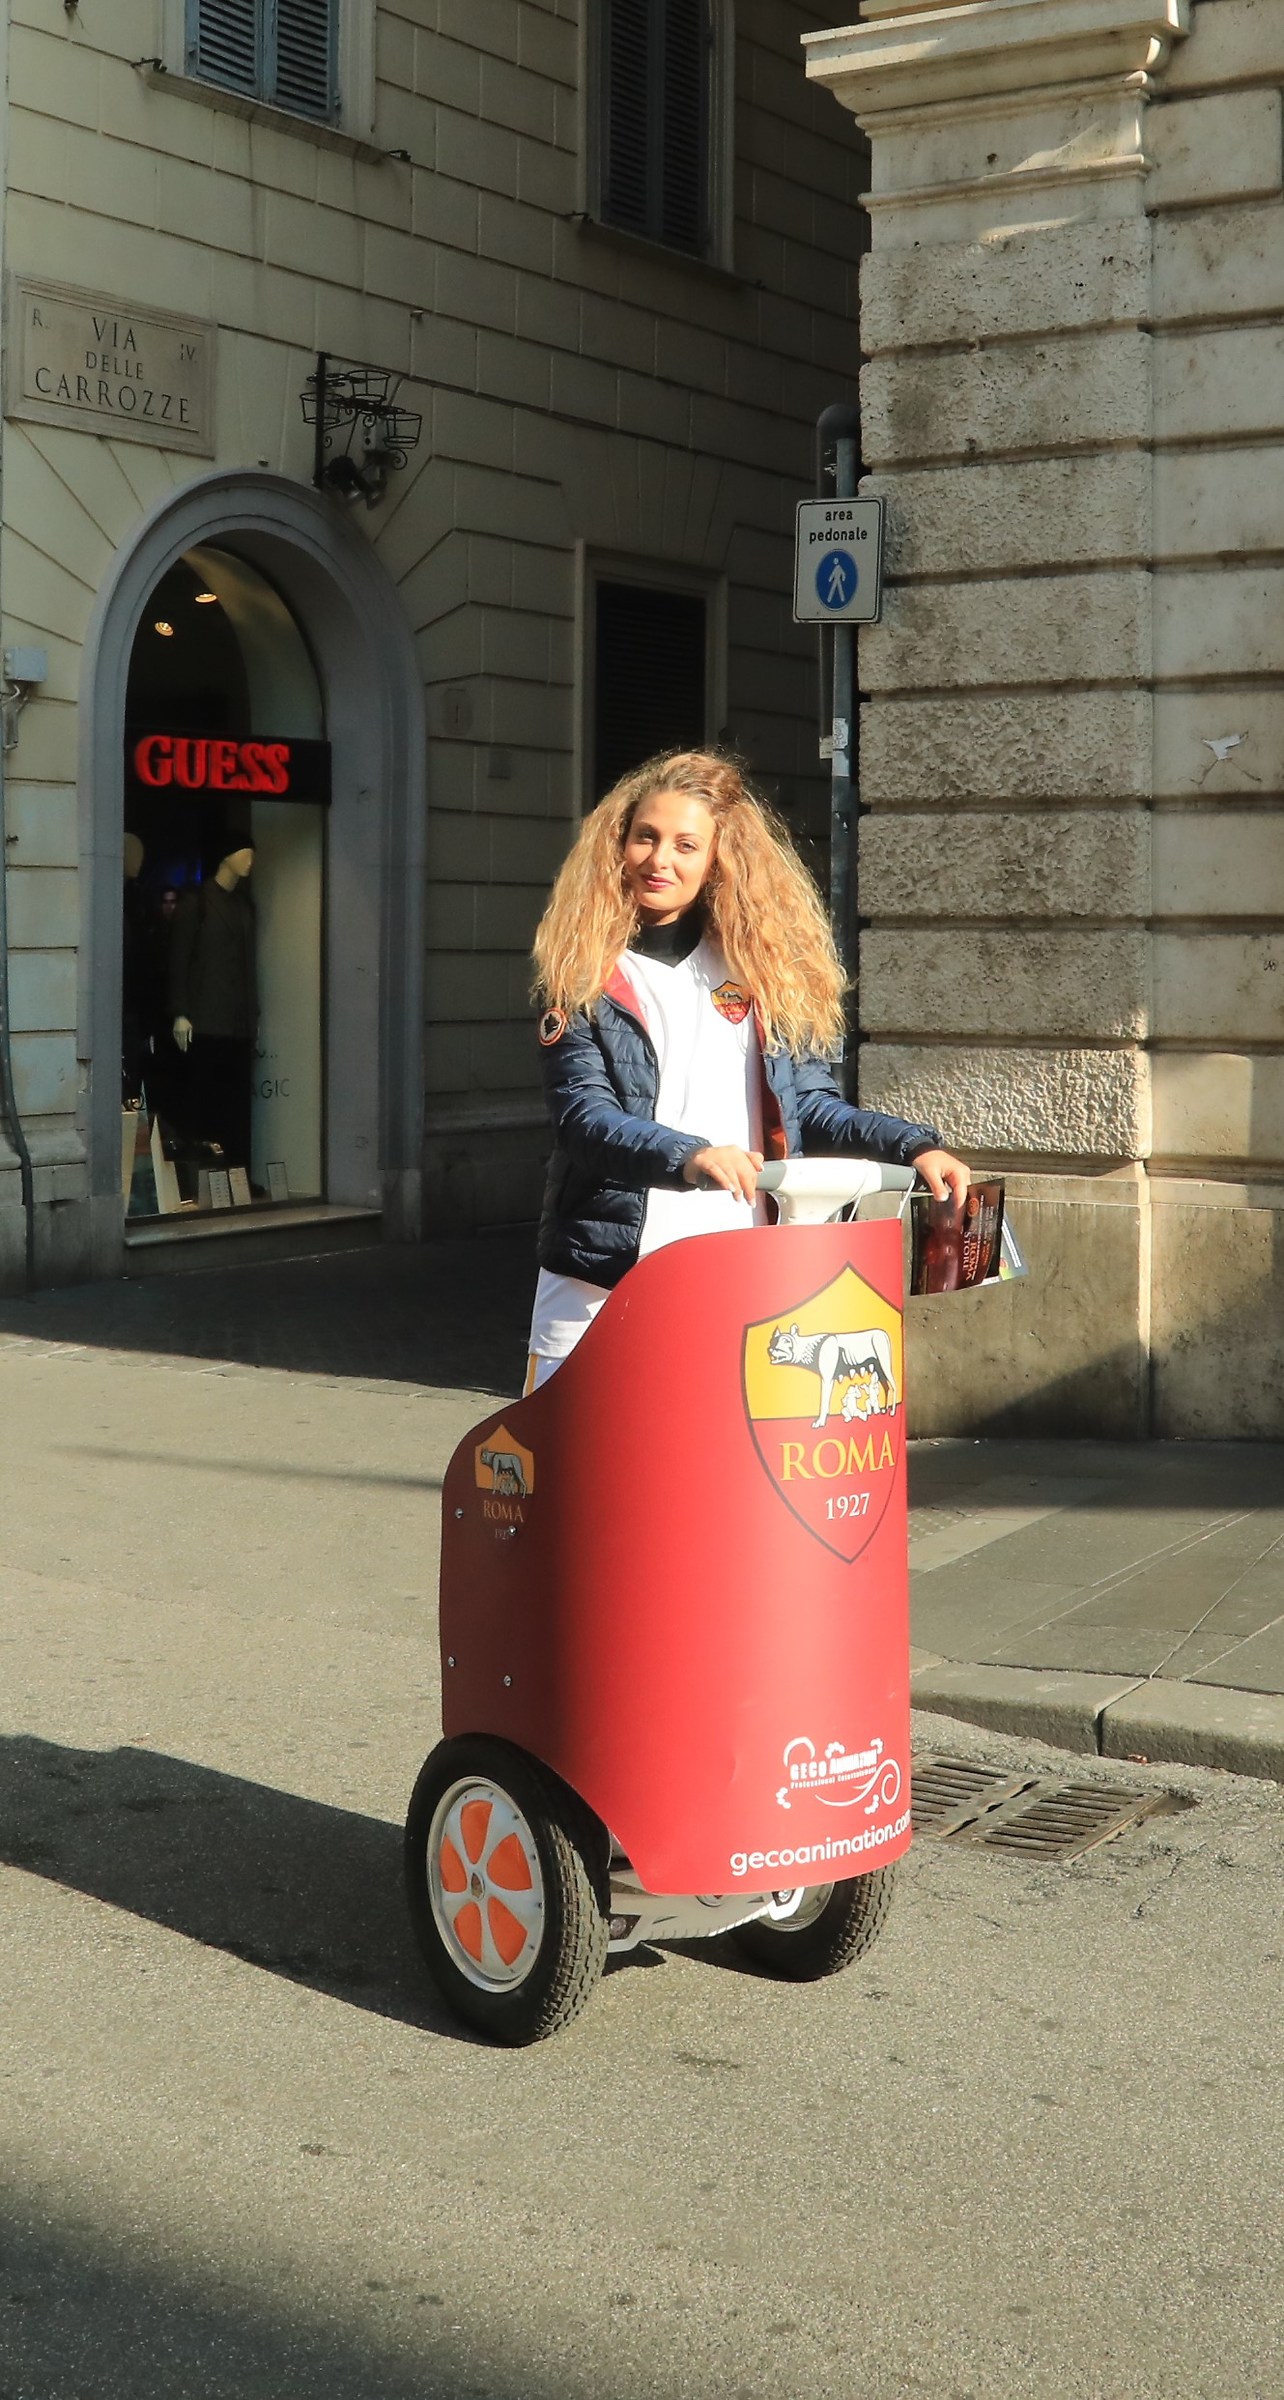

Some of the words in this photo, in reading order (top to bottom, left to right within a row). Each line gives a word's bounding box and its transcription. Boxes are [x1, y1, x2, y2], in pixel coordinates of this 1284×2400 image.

[92, 317, 137, 352] VIA
[86, 351, 144, 380] DELLE
[35, 367, 190, 423] CARROZZE
[825, 510, 853, 521] area
[809, 527, 868, 544] pedonale
[134, 735, 290, 794] GUESS
[779, 1430, 896, 1481] ROMA
[483, 1499, 524, 1523] ROMA
[825, 1492, 870, 1521] 1927
[790, 1760, 827, 1780] GECO
